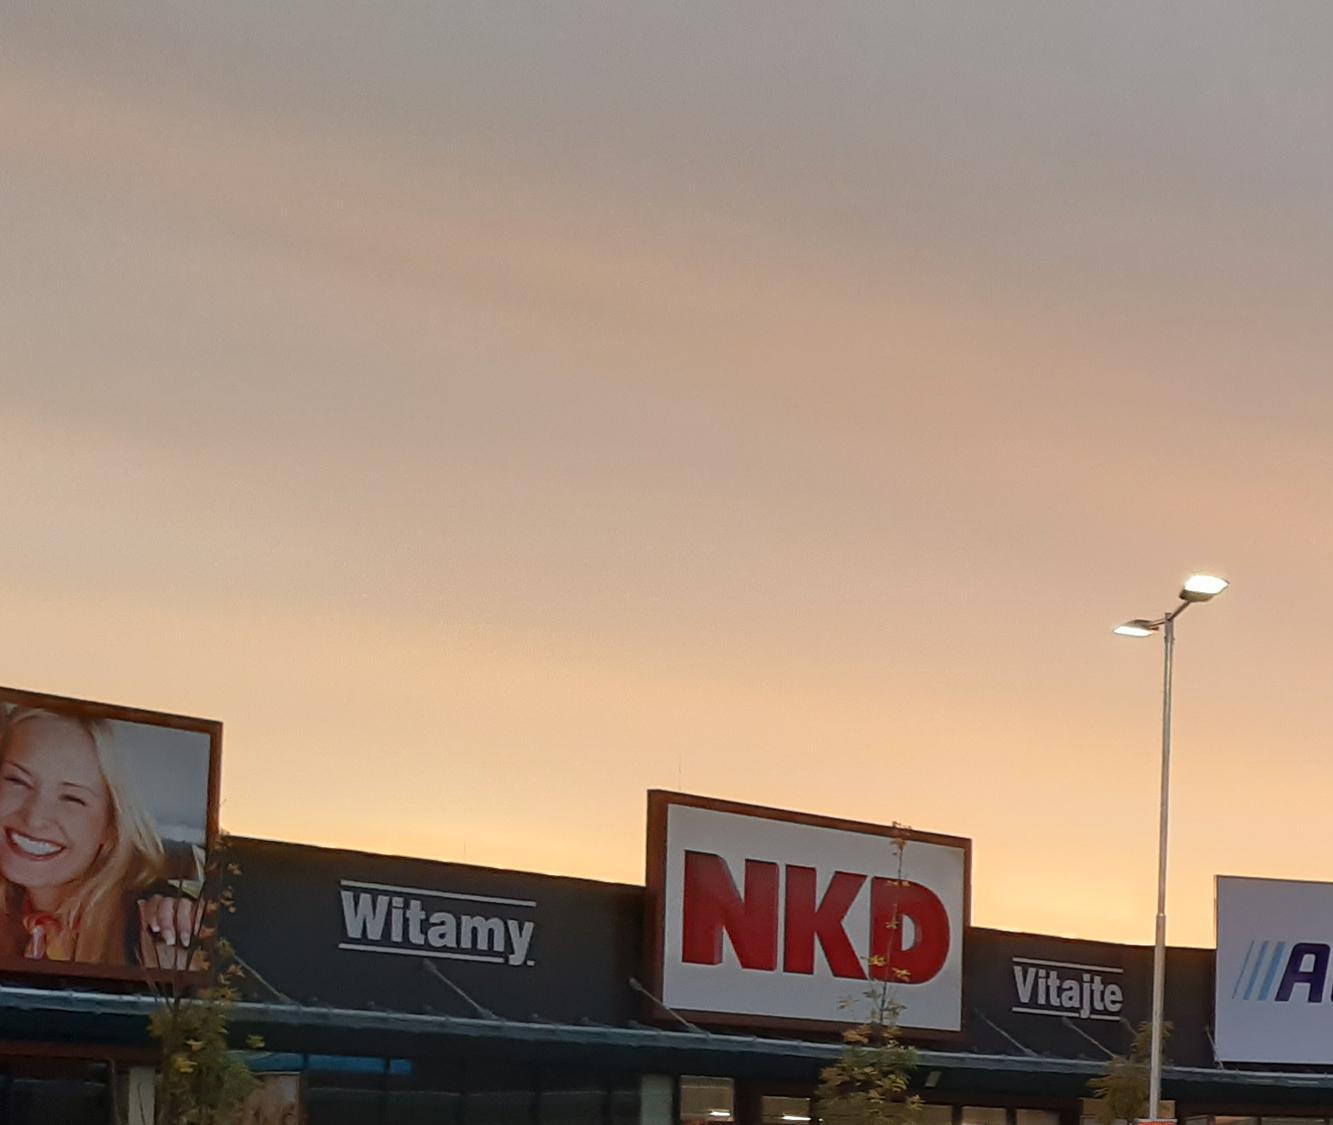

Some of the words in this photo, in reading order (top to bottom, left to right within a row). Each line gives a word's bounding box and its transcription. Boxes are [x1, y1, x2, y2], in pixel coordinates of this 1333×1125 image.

[340, 890, 535, 966] Witamy
[682, 849, 951, 985] NKD
[1013, 965, 1123, 1019] Vitajte
